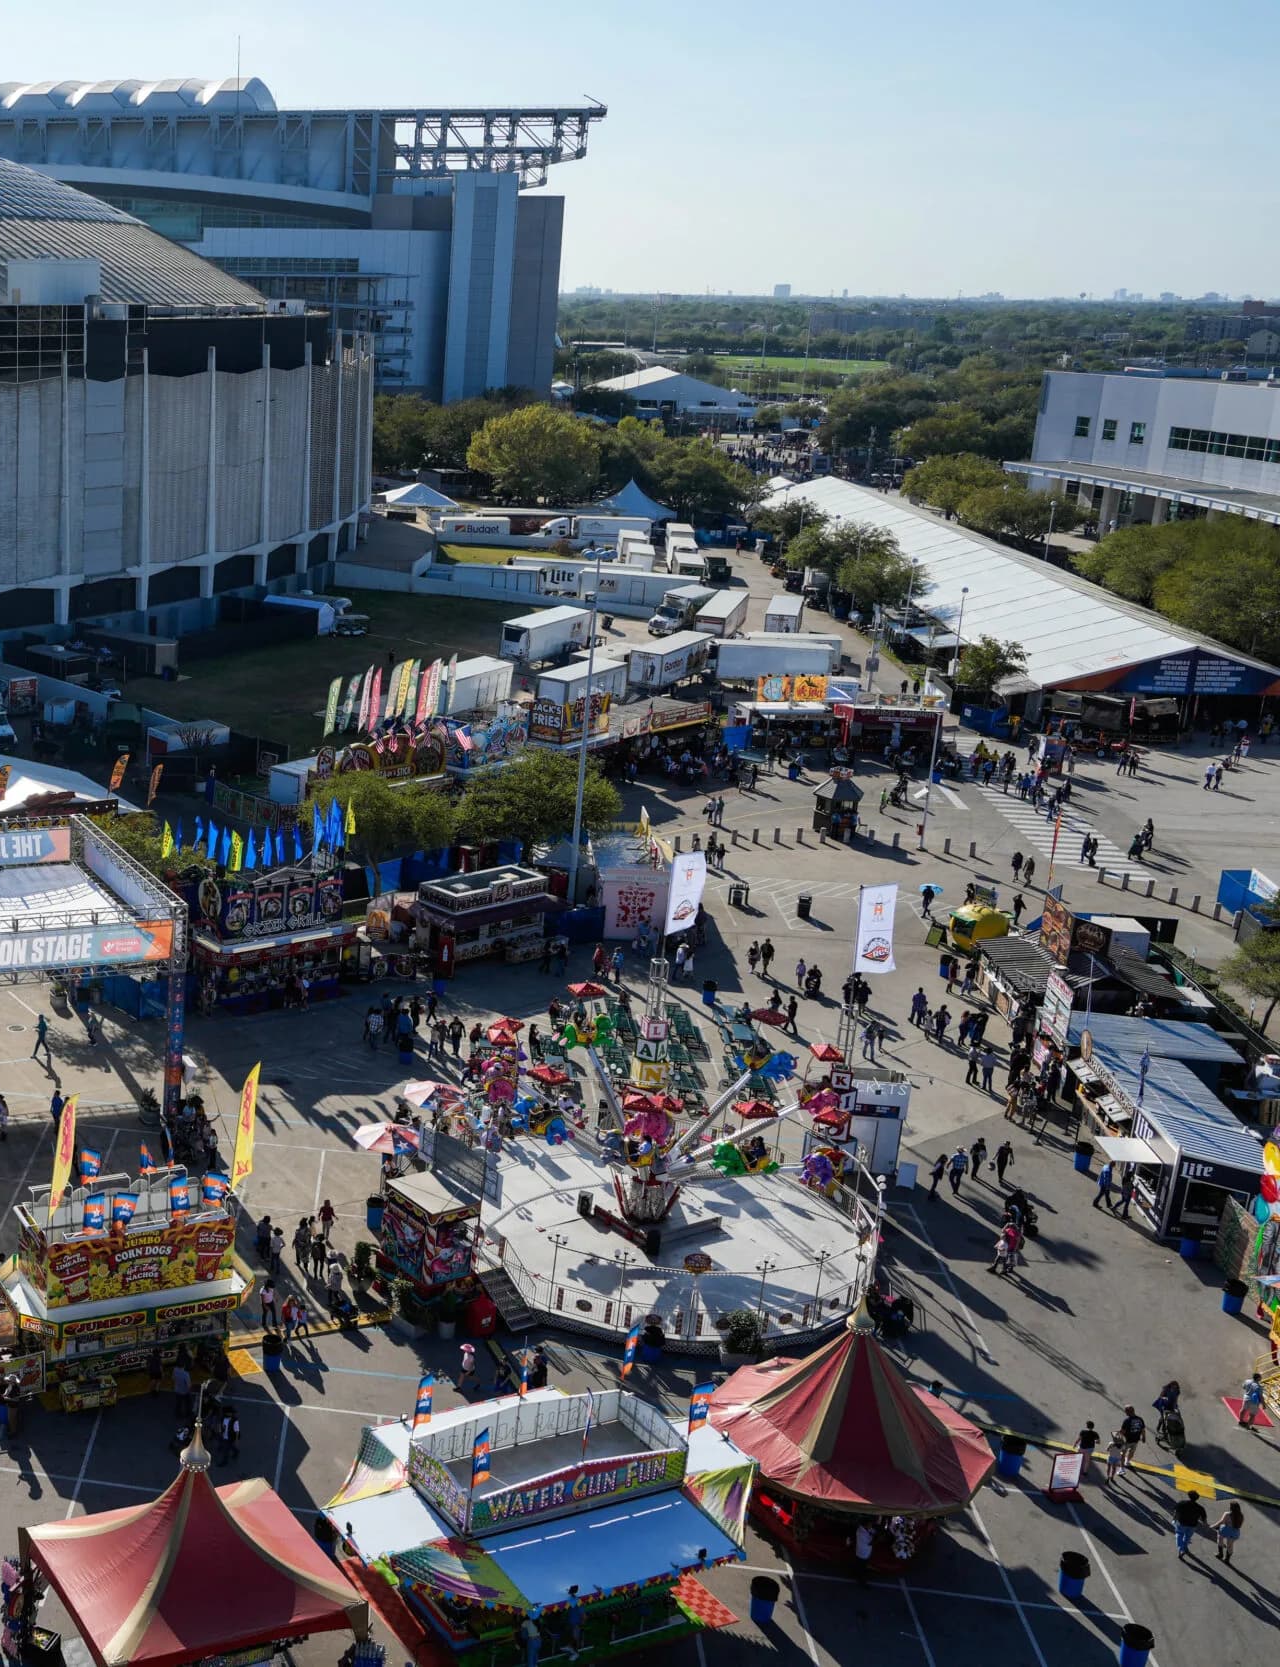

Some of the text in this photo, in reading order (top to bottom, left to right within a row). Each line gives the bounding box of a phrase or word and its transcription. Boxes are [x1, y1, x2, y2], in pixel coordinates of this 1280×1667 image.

[466, 525, 499, 536] Budget
[550, 567, 574, 584] Lite
[532, 703, 561, 715] JACK'S
[532, 713, 561, 729] FRIES
[243, 912, 325, 936] GREEK GRILL
[30, 933, 92, 962] STAGE
[653, 1026, 660, 1035] L
[640, 1044, 652, 1057] A
[646, 1067, 662, 1081] N
[835, 1076, 847, 1086] K
[1134, 1113, 1154, 1142] Lite
[1181, 1161, 1214, 1177] Lite
[124, 1236, 161, 1249] JUMBO
[115, 1245, 174, 1263] CORN DOGS
[125, 1271, 160, 1283] NACHOS
[166, 1300, 228, 1319] CORN DOGS
[23, 1322, 56, 1336] LEMONADE
[77, 1316, 134, 1333] JUMBO
[487, 1456, 667, 1521] WATER GUN FUN
